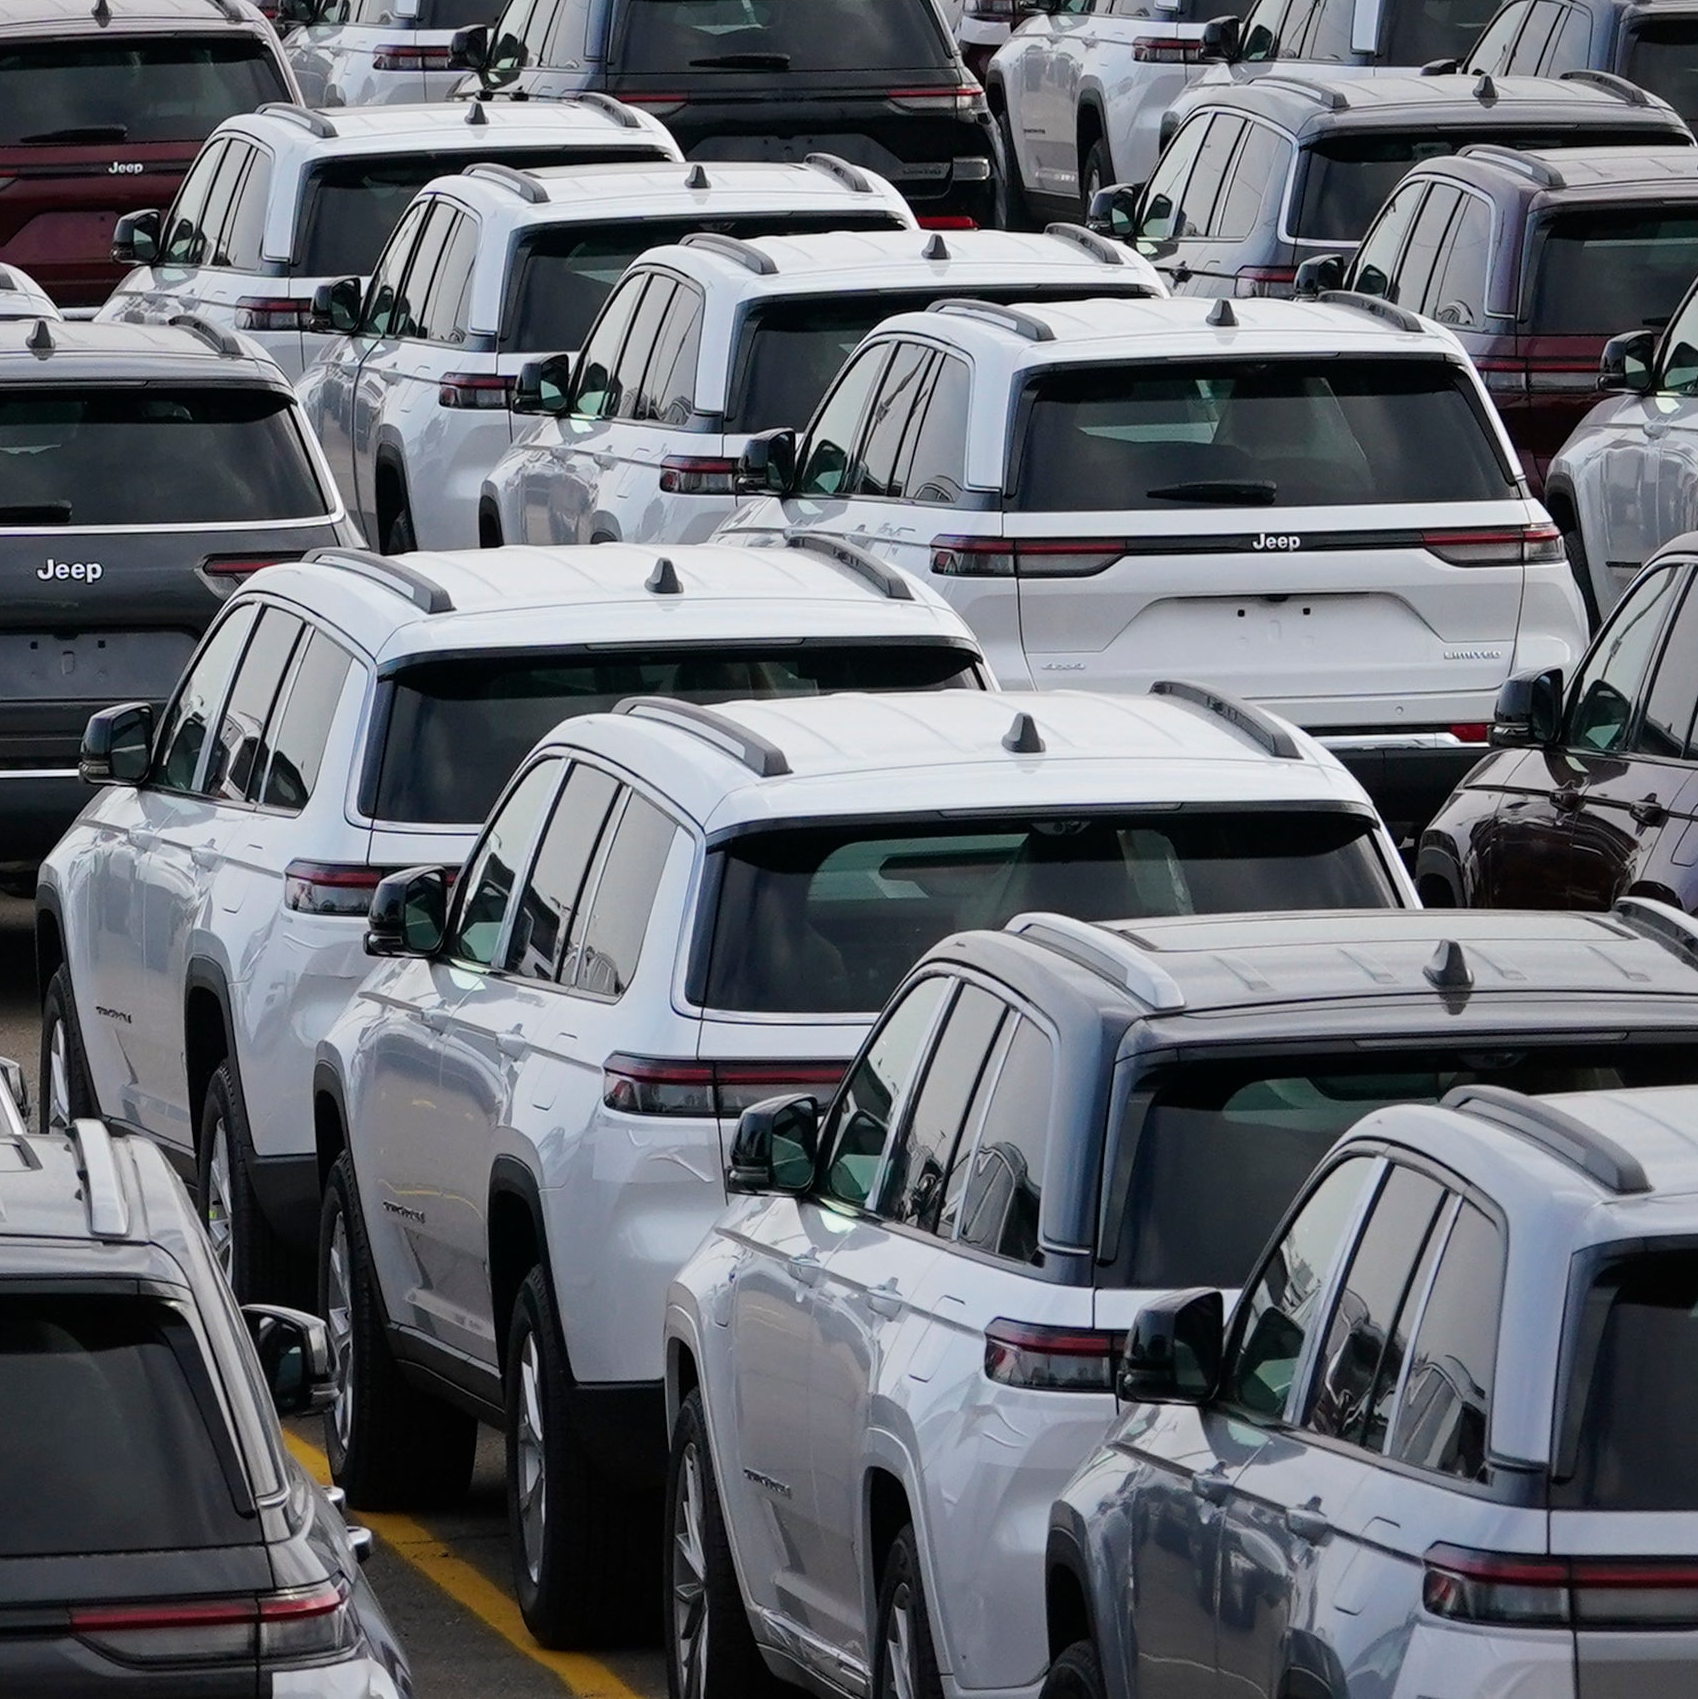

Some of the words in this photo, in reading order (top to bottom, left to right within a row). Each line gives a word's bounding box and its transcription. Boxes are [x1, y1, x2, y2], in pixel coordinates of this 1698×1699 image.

[108, 161, 143, 175] Jeep
[1252, 533, 1300, 552] Jeep
[36, 558, 103, 584] Jeep
